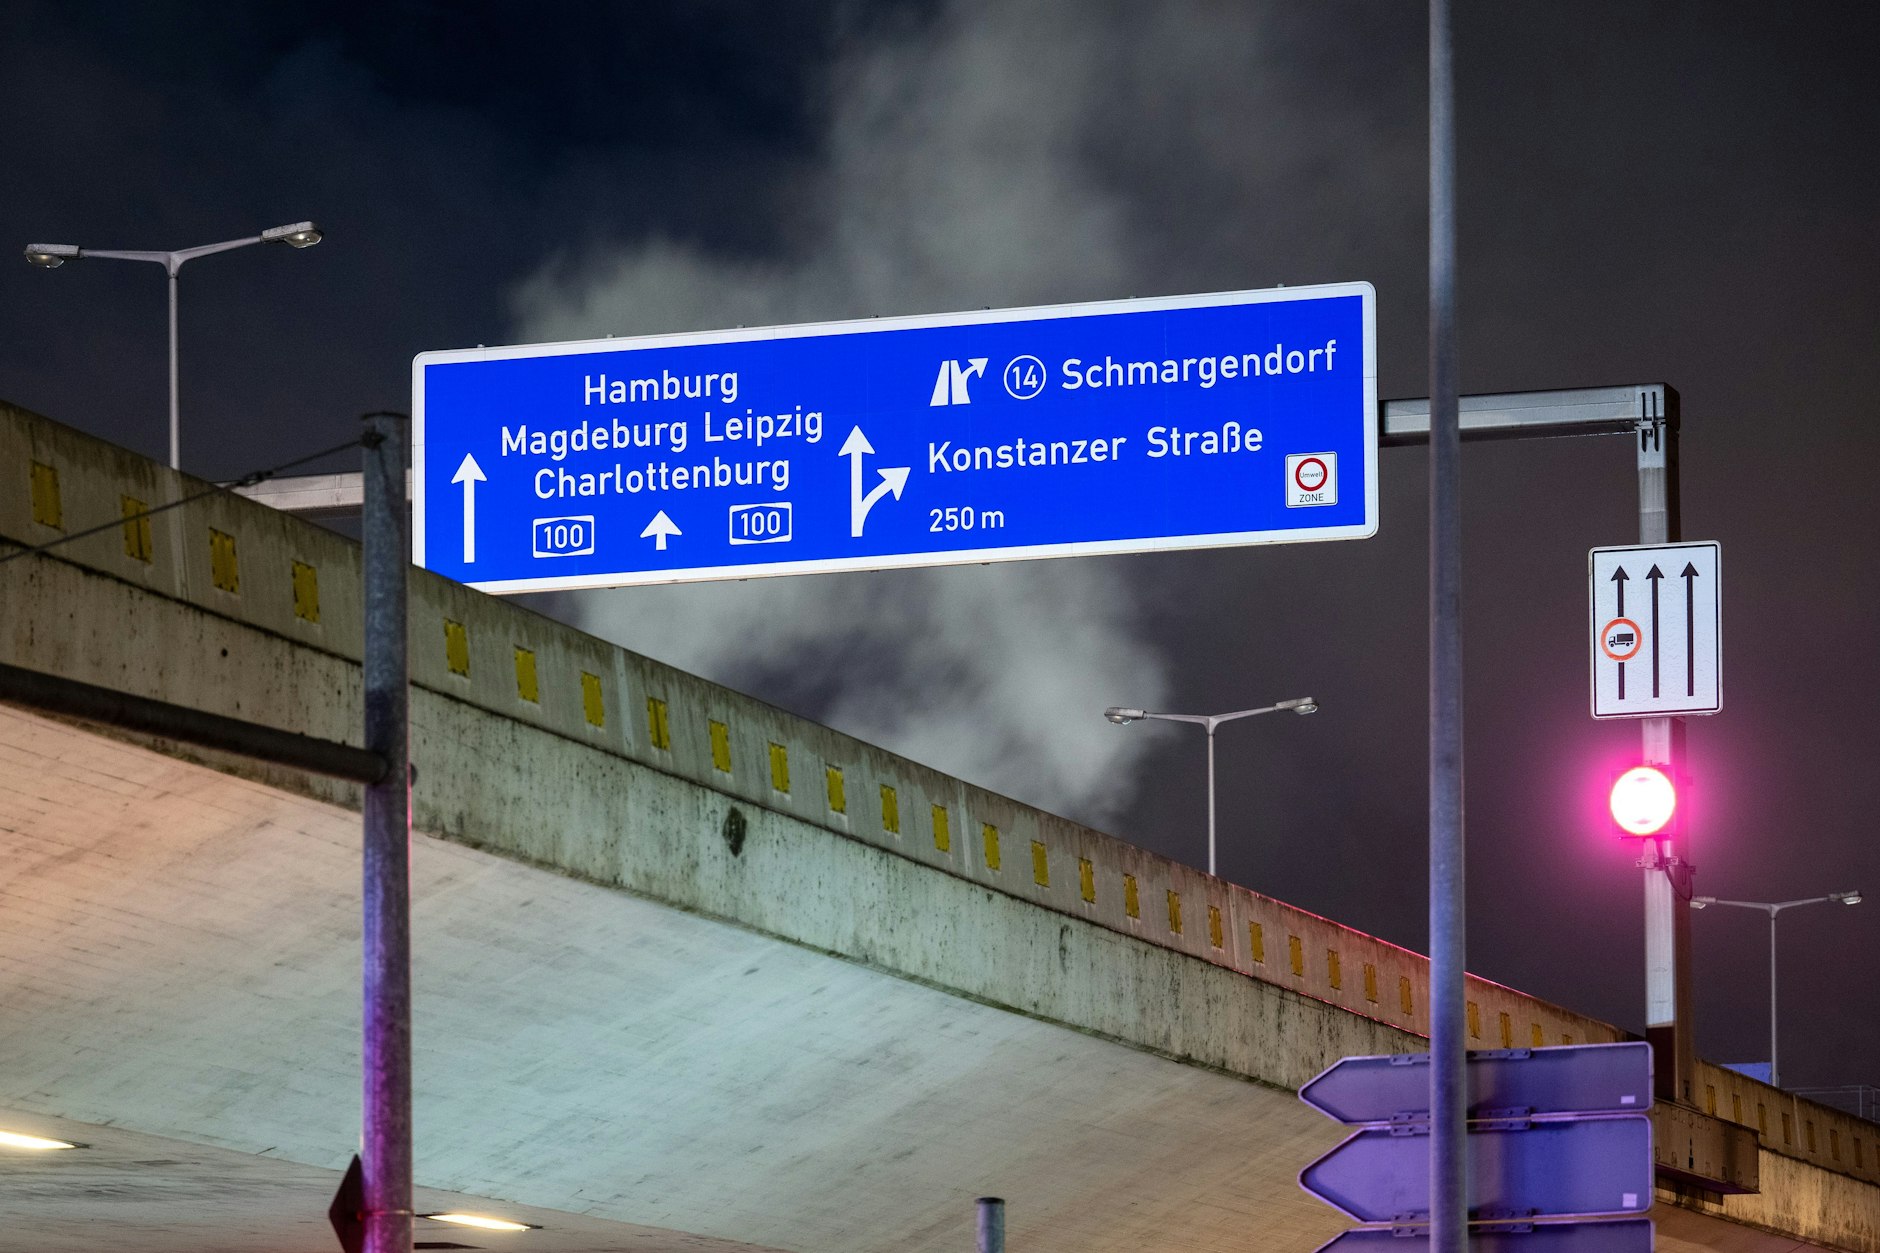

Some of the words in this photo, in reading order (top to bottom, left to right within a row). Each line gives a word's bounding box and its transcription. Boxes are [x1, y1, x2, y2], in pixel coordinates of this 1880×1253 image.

[1013, 364, 1038, 390] 14
[1061, 339, 1337, 390] Schmargendorf
[584, 369, 738, 406] Hamburg
[501, 418, 687, 461] Magdeburg
[704, 405, 823, 447] Leipzig
[929, 437, 1127, 474] Konstanzer
[1146, 421, 1263, 458] Straße
[534, 456, 790, 500] Charlottenburg
[1299, 471, 1323, 479] Umwelt
[1299, 493, 1324, 503] ZONE
[740, 510, 781, 537] 100
[929, 506, 975, 533] 250
[981, 510, 1005, 529] m
[544, 523, 584, 550] 100
